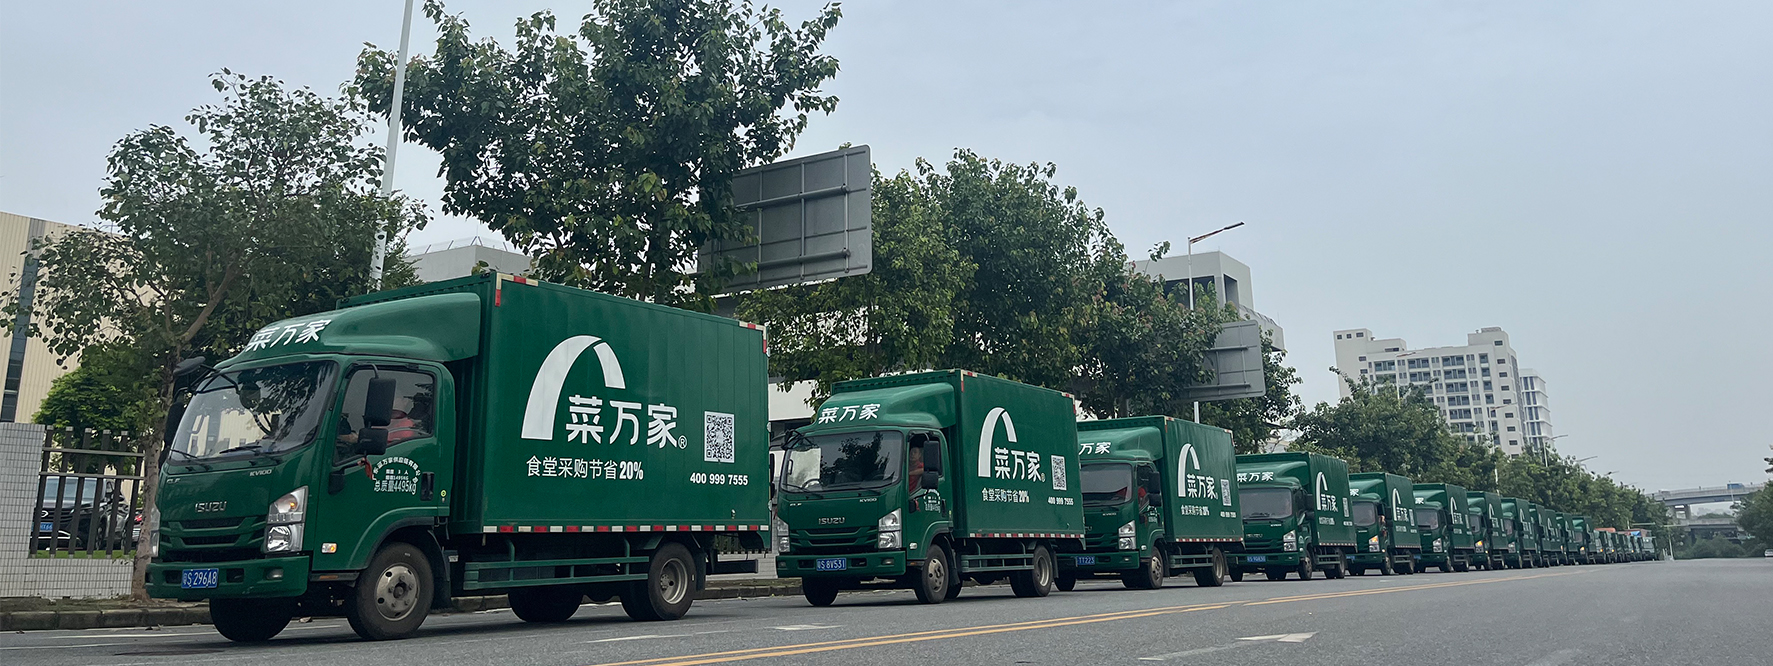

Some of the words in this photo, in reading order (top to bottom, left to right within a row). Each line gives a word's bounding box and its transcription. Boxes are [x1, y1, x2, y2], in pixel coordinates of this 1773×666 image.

[245, 320, 331, 352] 菜万家
[566, 395, 678, 448] 菜万家
[818, 403, 880, 424] 菜万家
[1078, 442, 1111, 455] 万家
[249, 469, 272, 477] KV100
[526, 455, 644, 480] 食堂采购节省20%
[994, 447, 1041, 482] 菜万家
[690, 472, 707, 484] 400
[709, 473, 726, 485] 999
[728, 474, 749, 486] 7555
[1187, 473, 1217, 500] 菜万家
[195, 501, 228, 513] ISUZU
[818, 517, 846, 525] ISUZU
